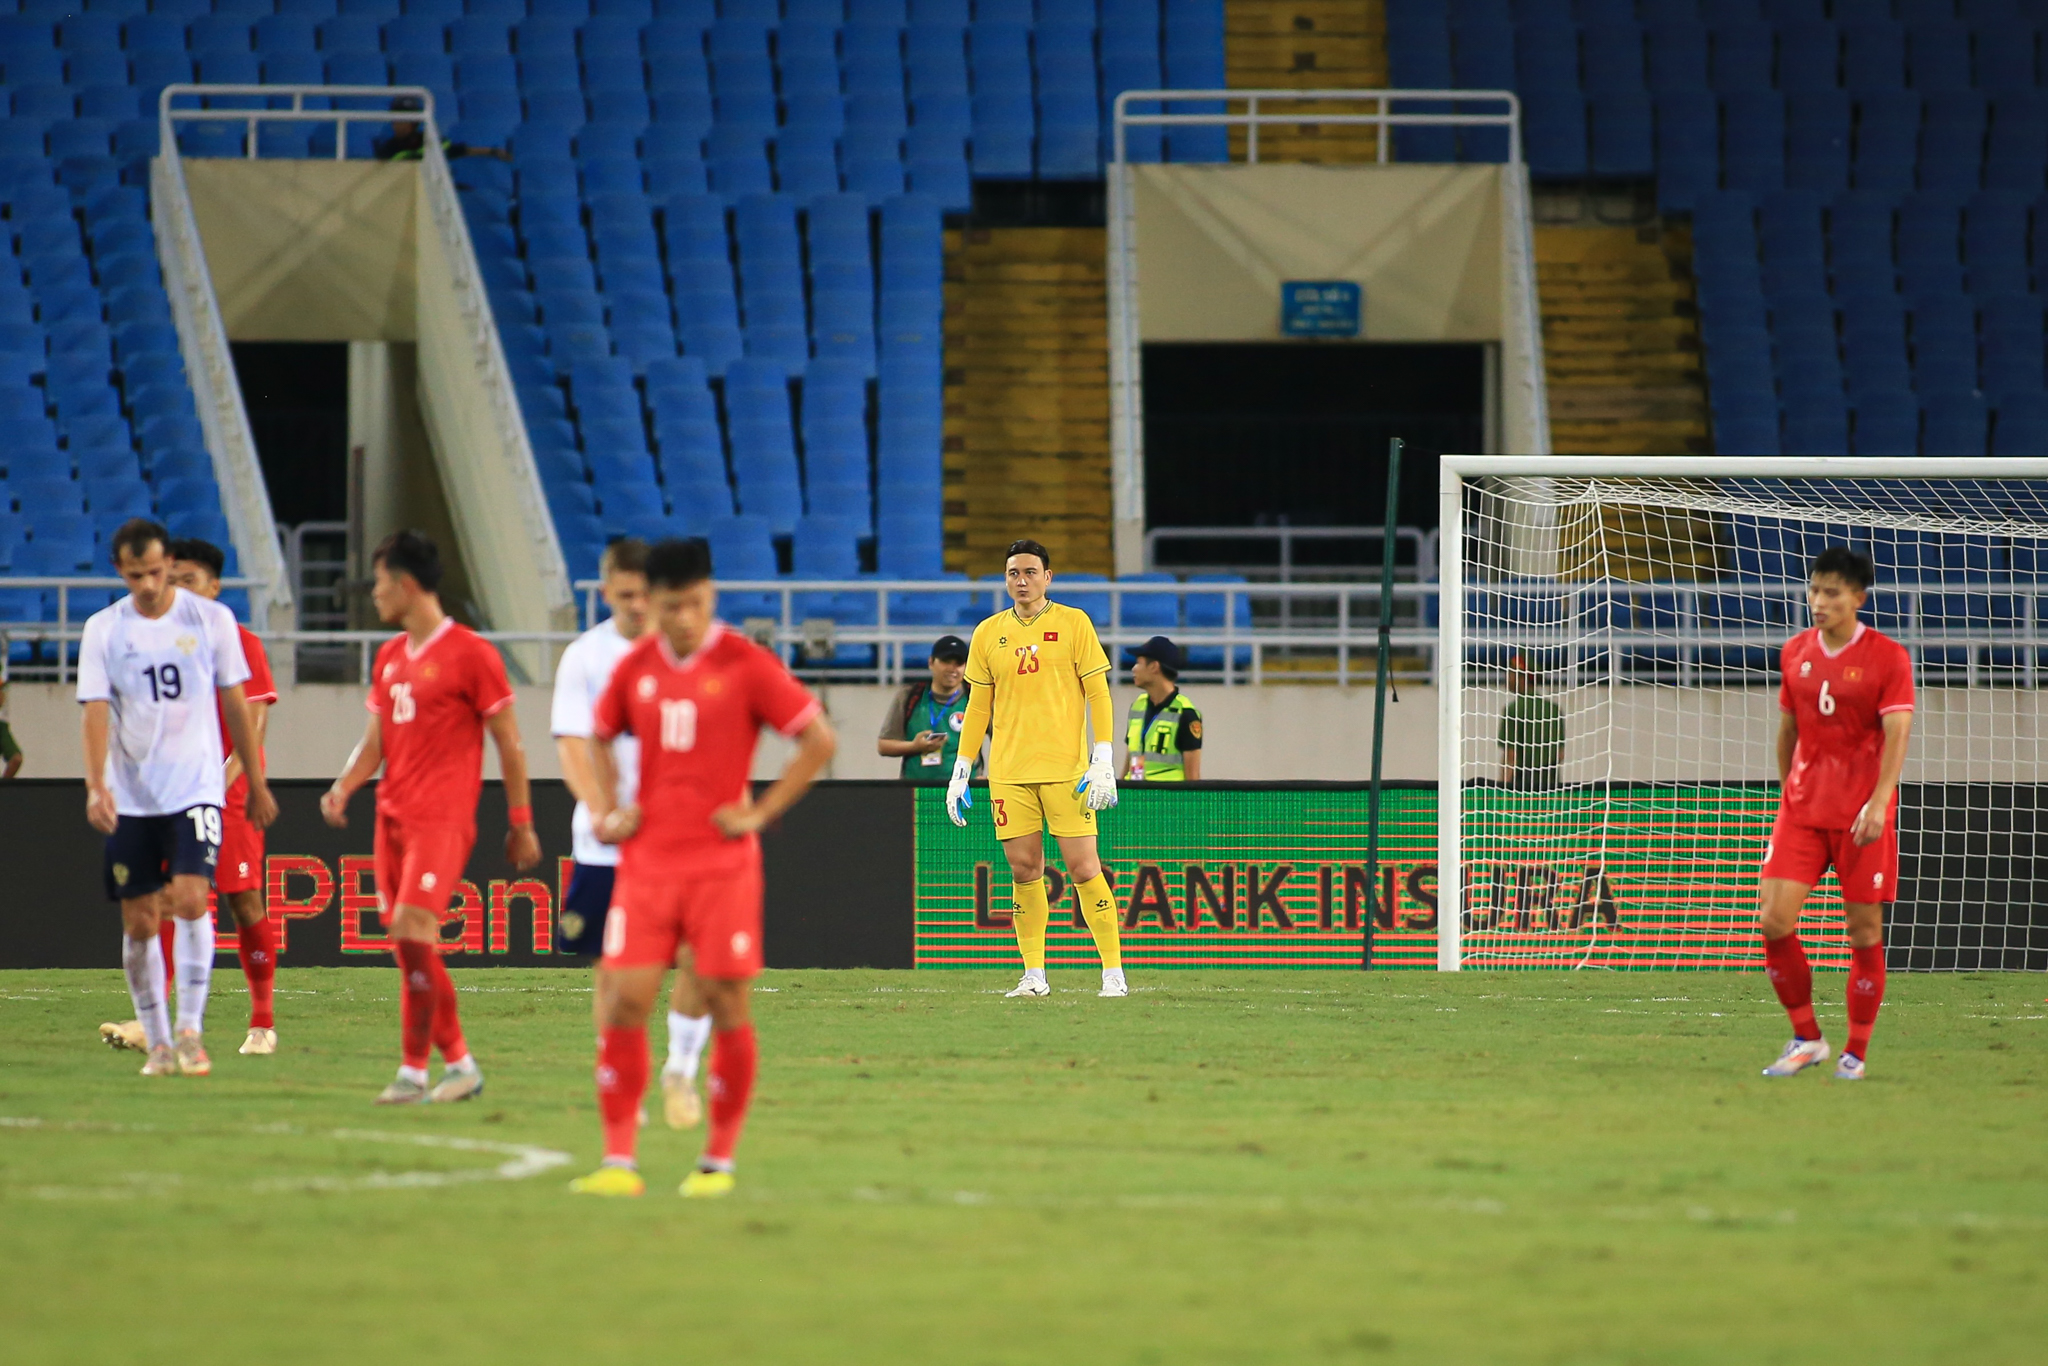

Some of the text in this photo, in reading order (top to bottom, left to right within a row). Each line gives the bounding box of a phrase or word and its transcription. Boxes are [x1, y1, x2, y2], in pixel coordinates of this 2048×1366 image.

[1015, 645, 1039, 675] 23
[142, 663, 182, 702] 19
[1818, 680, 1836, 716] 6
[389, 681, 416, 724] 26
[659, 698, 698, 753] 10
[186, 805, 222, 847] 19
[991, 799, 1008, 827] 3
